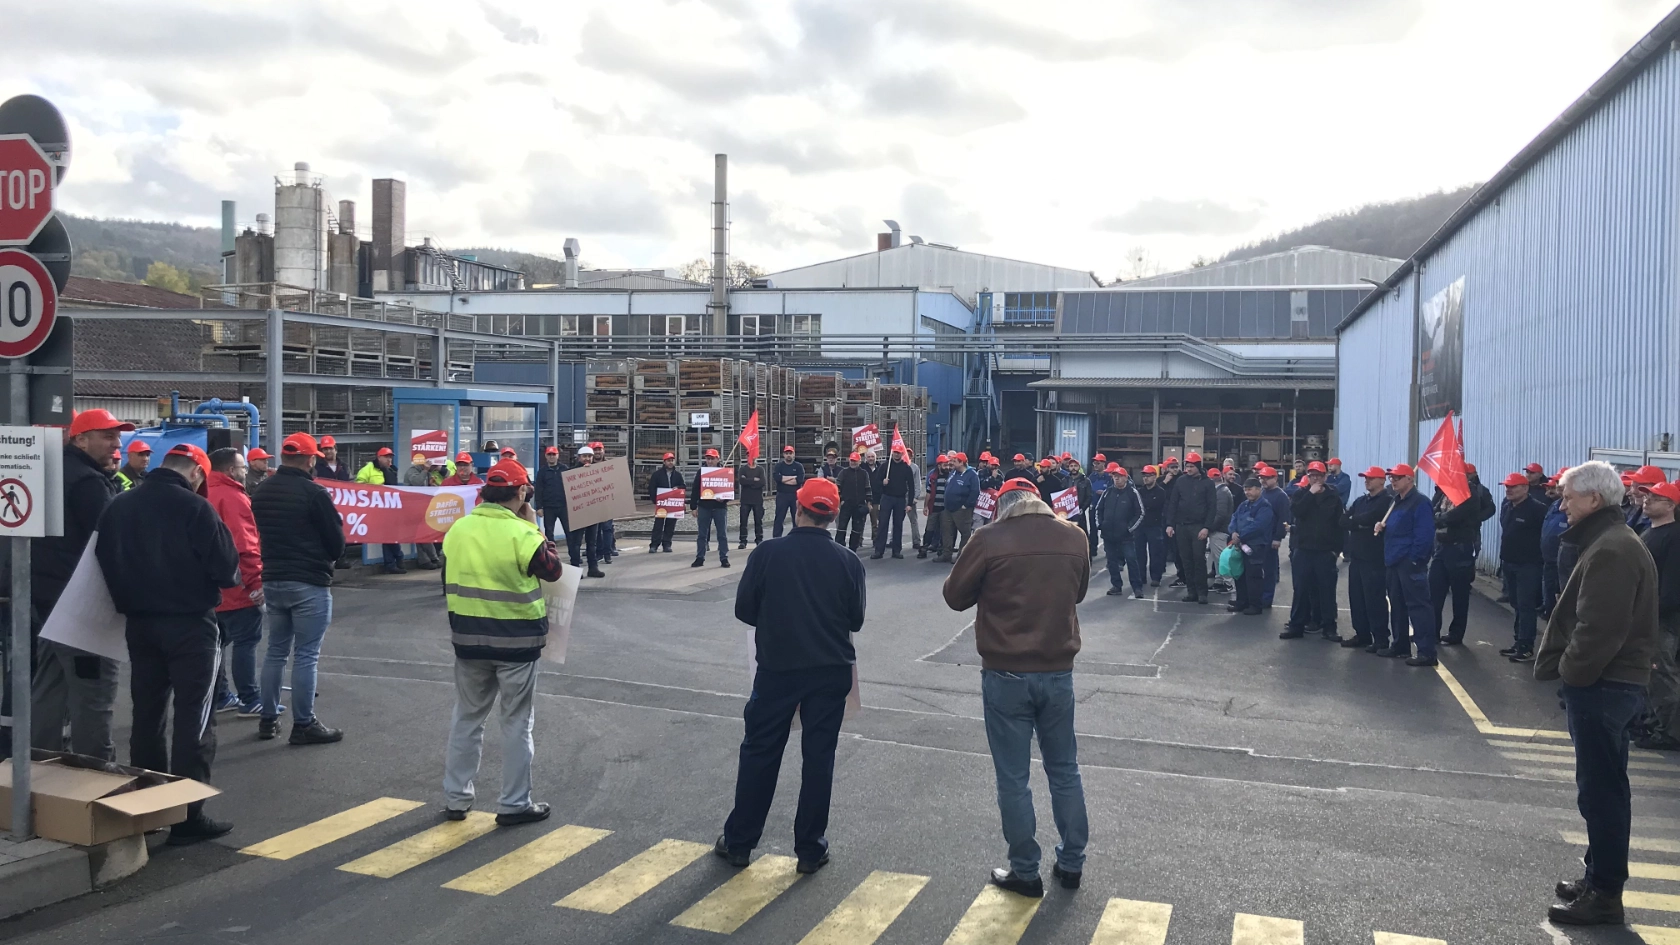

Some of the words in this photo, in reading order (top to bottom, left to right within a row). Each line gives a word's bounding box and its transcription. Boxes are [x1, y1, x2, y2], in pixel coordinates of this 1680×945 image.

[856, 433, 879, 442] STREITEN
[412, 442, 447, 452] STÄRKEN!
[436, 499, 458, 509] DAFÜR
[656, 499, 684, 507] STÄRKEN!
[429, 507, 461, 517] STREITEN
[437, 516, 454, 524] WIR!
